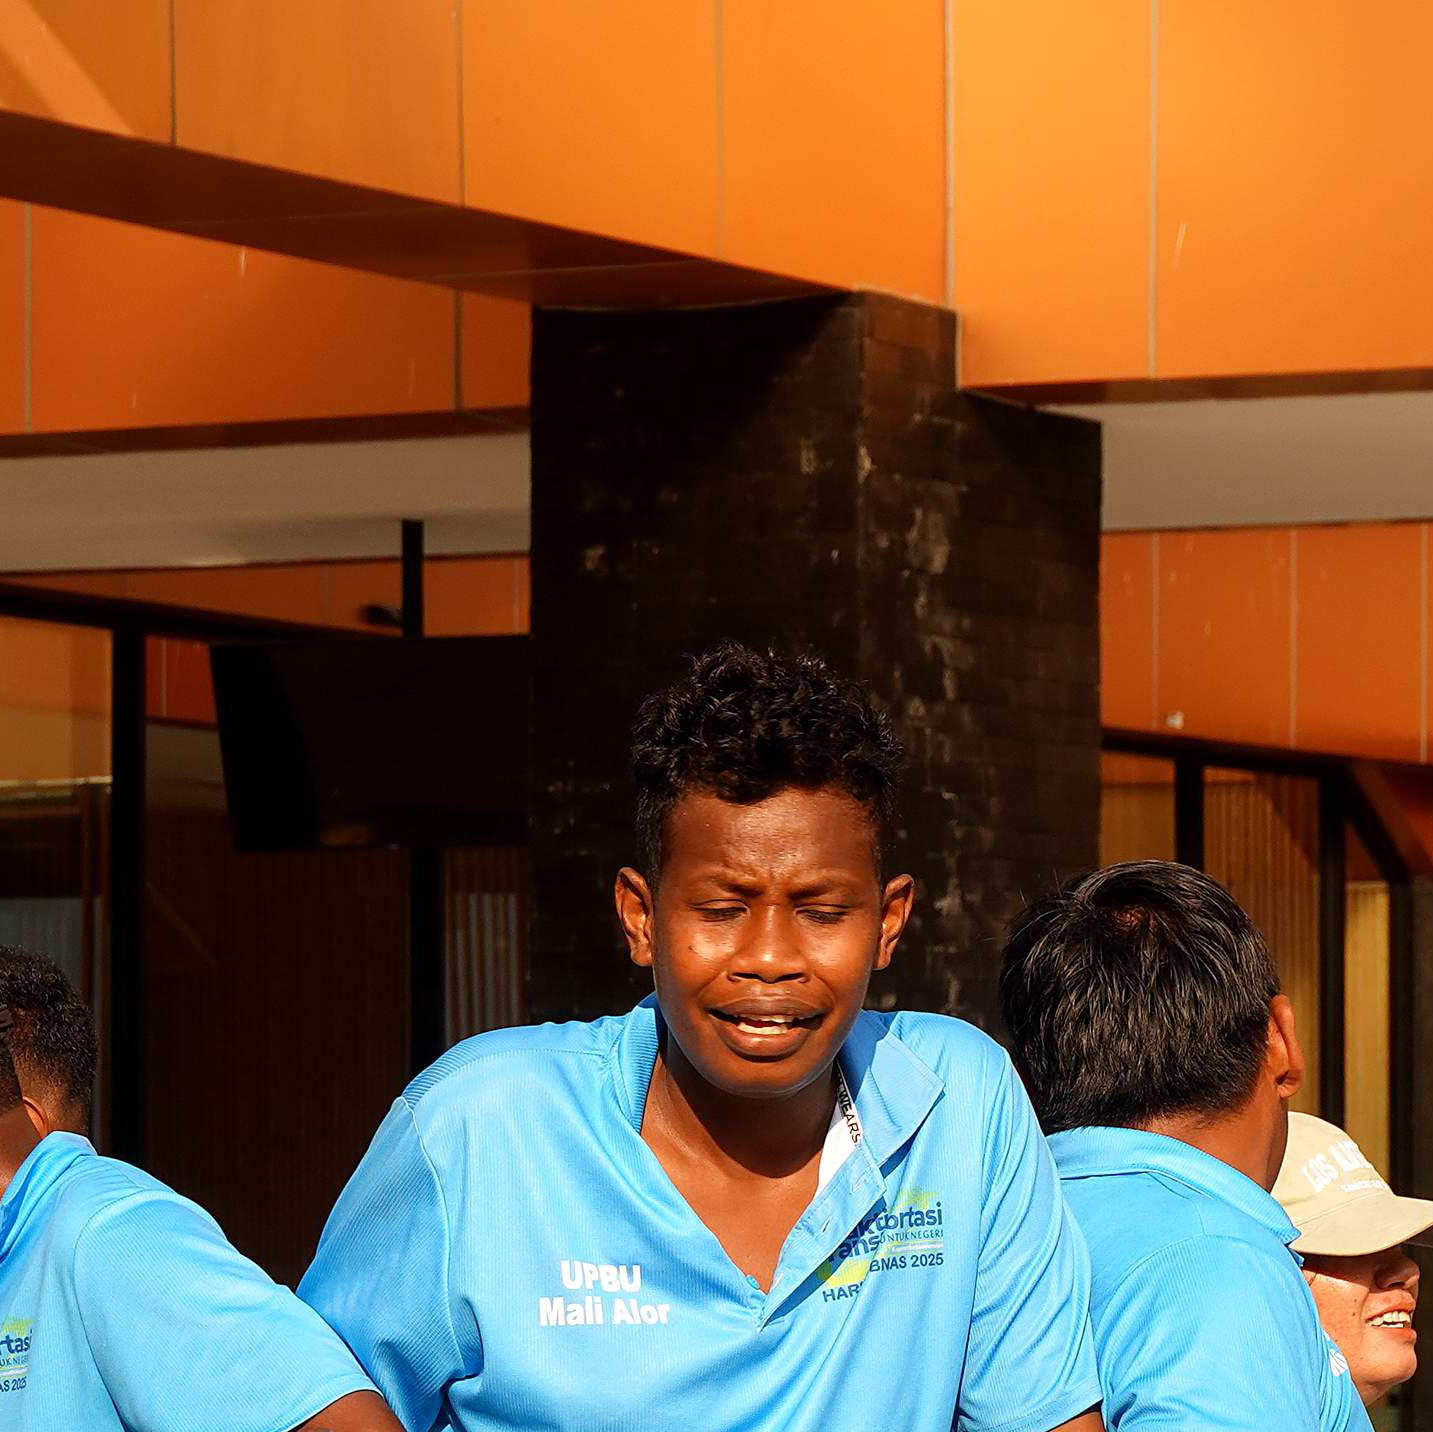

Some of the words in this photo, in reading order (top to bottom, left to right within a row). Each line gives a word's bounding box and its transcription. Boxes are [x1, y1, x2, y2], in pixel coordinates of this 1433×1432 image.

[560, 1259, 642, 1293] UPBU
[910, 1253, 944, 1268] 2025
[539, 1296, 604, 1327] Mali
[612, 1298, 670, 1325] Alor
